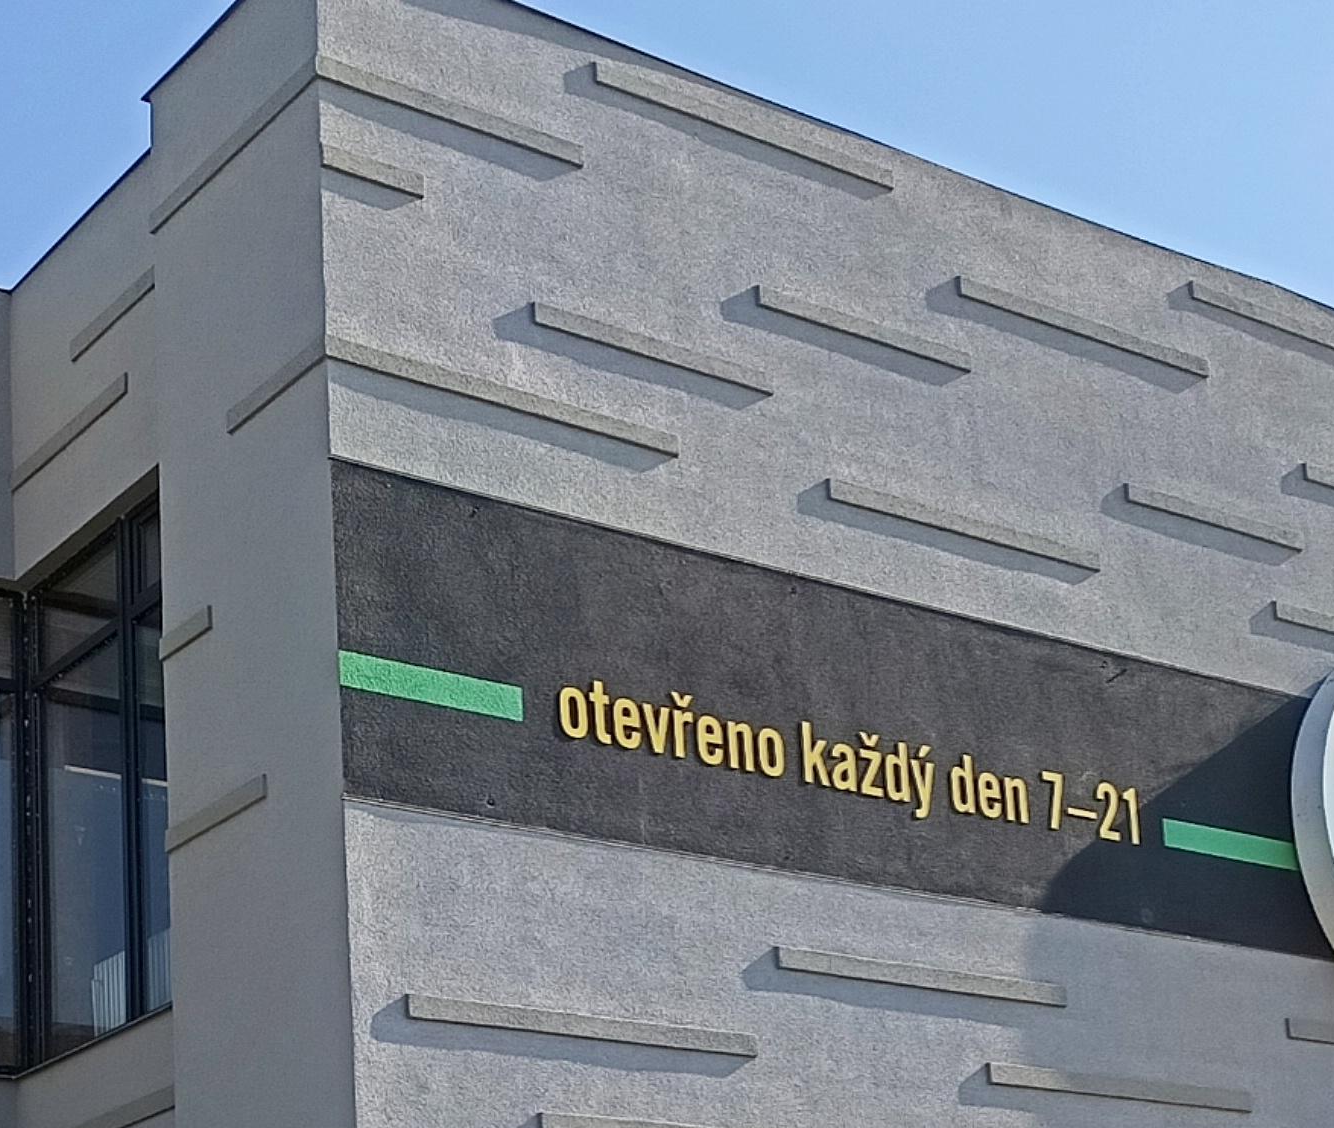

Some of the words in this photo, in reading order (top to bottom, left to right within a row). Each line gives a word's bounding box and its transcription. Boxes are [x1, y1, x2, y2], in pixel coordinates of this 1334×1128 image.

[558, 679, 785, 777] otevřeno
[801, 720, 935, 819] každý
[950, 753, 1029, 824] den
